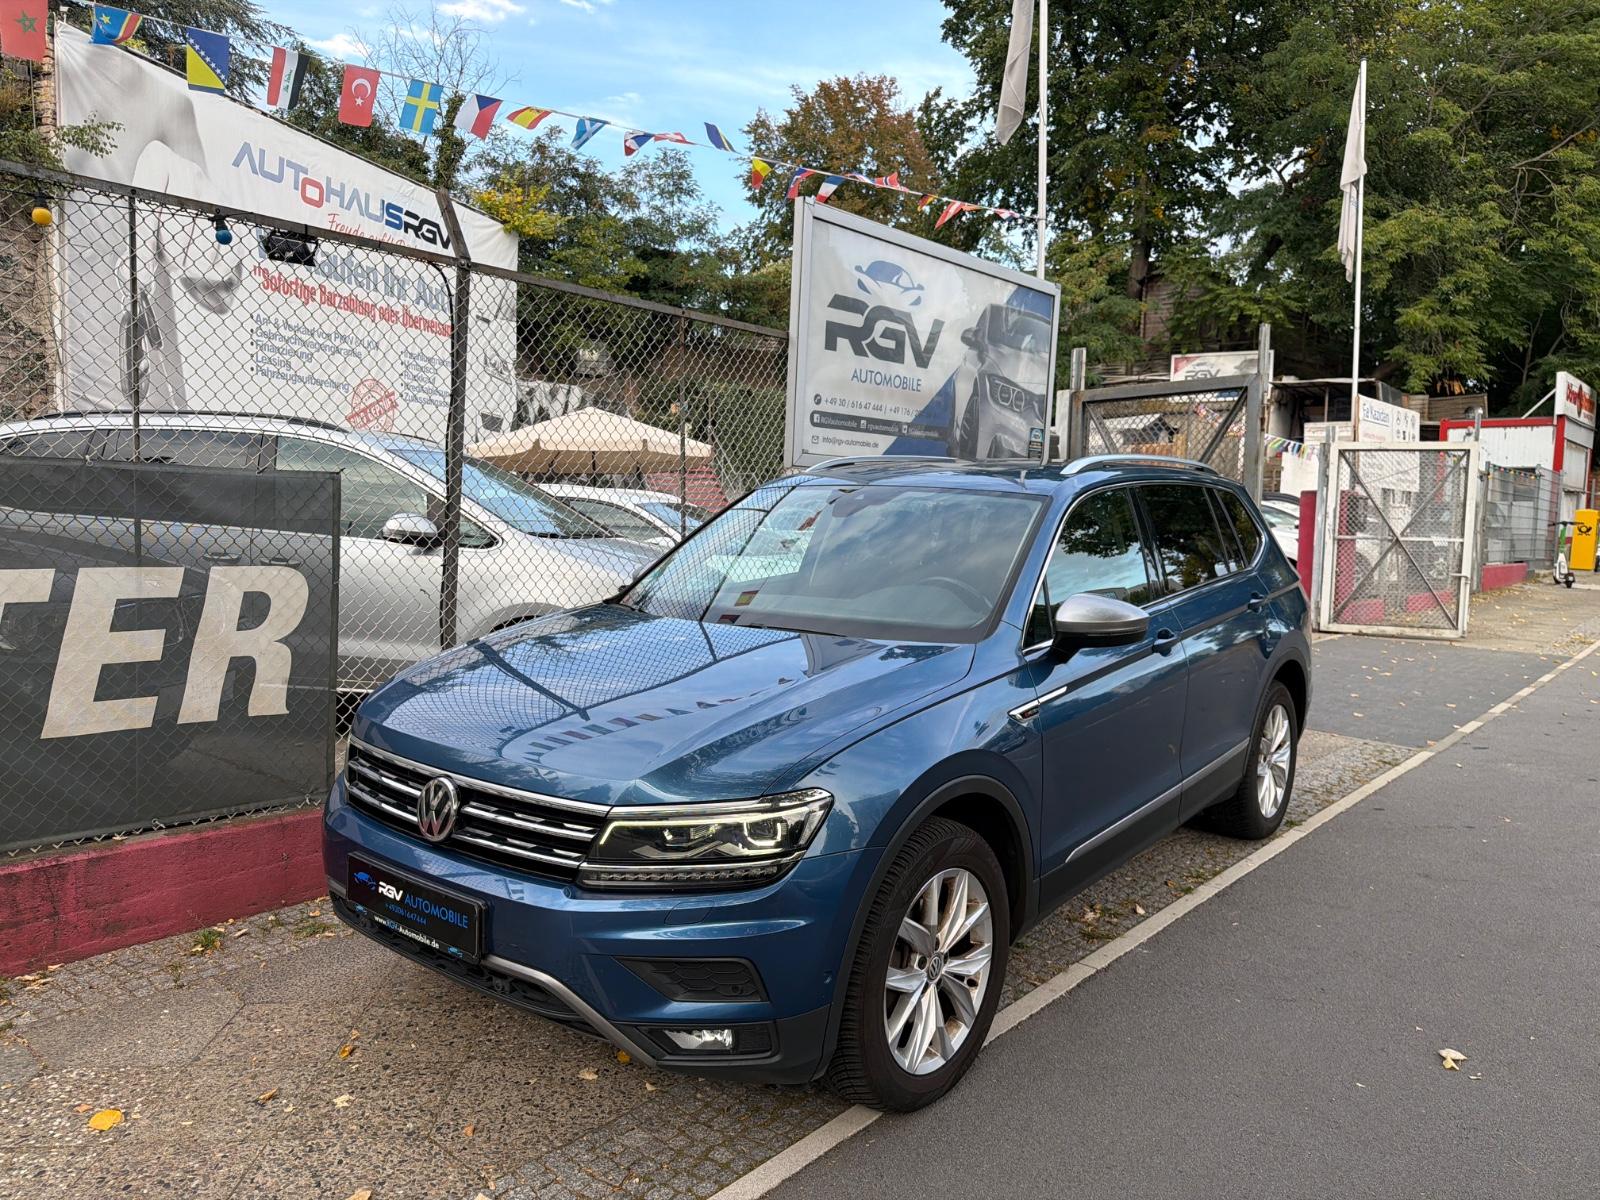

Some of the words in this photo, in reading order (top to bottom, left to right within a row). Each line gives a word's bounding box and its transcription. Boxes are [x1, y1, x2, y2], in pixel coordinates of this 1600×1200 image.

[308, 250, 381, 291] aufen
[320, 283, 376, 323] Barzahlung
[379, 302, 400, 325] oder
[402, 303, 452, 337] Überweisun
[255, 339, 314, 364] Finanzierung
[824, 294, 945, 370] RGV
[256, 353, 292, 371] Leasing
[851, 368, 922, 392] AUTOMOBILE
[378, 881, 403, 901] RGV
[405, 893, 469, 929] AUTOMOBILE
